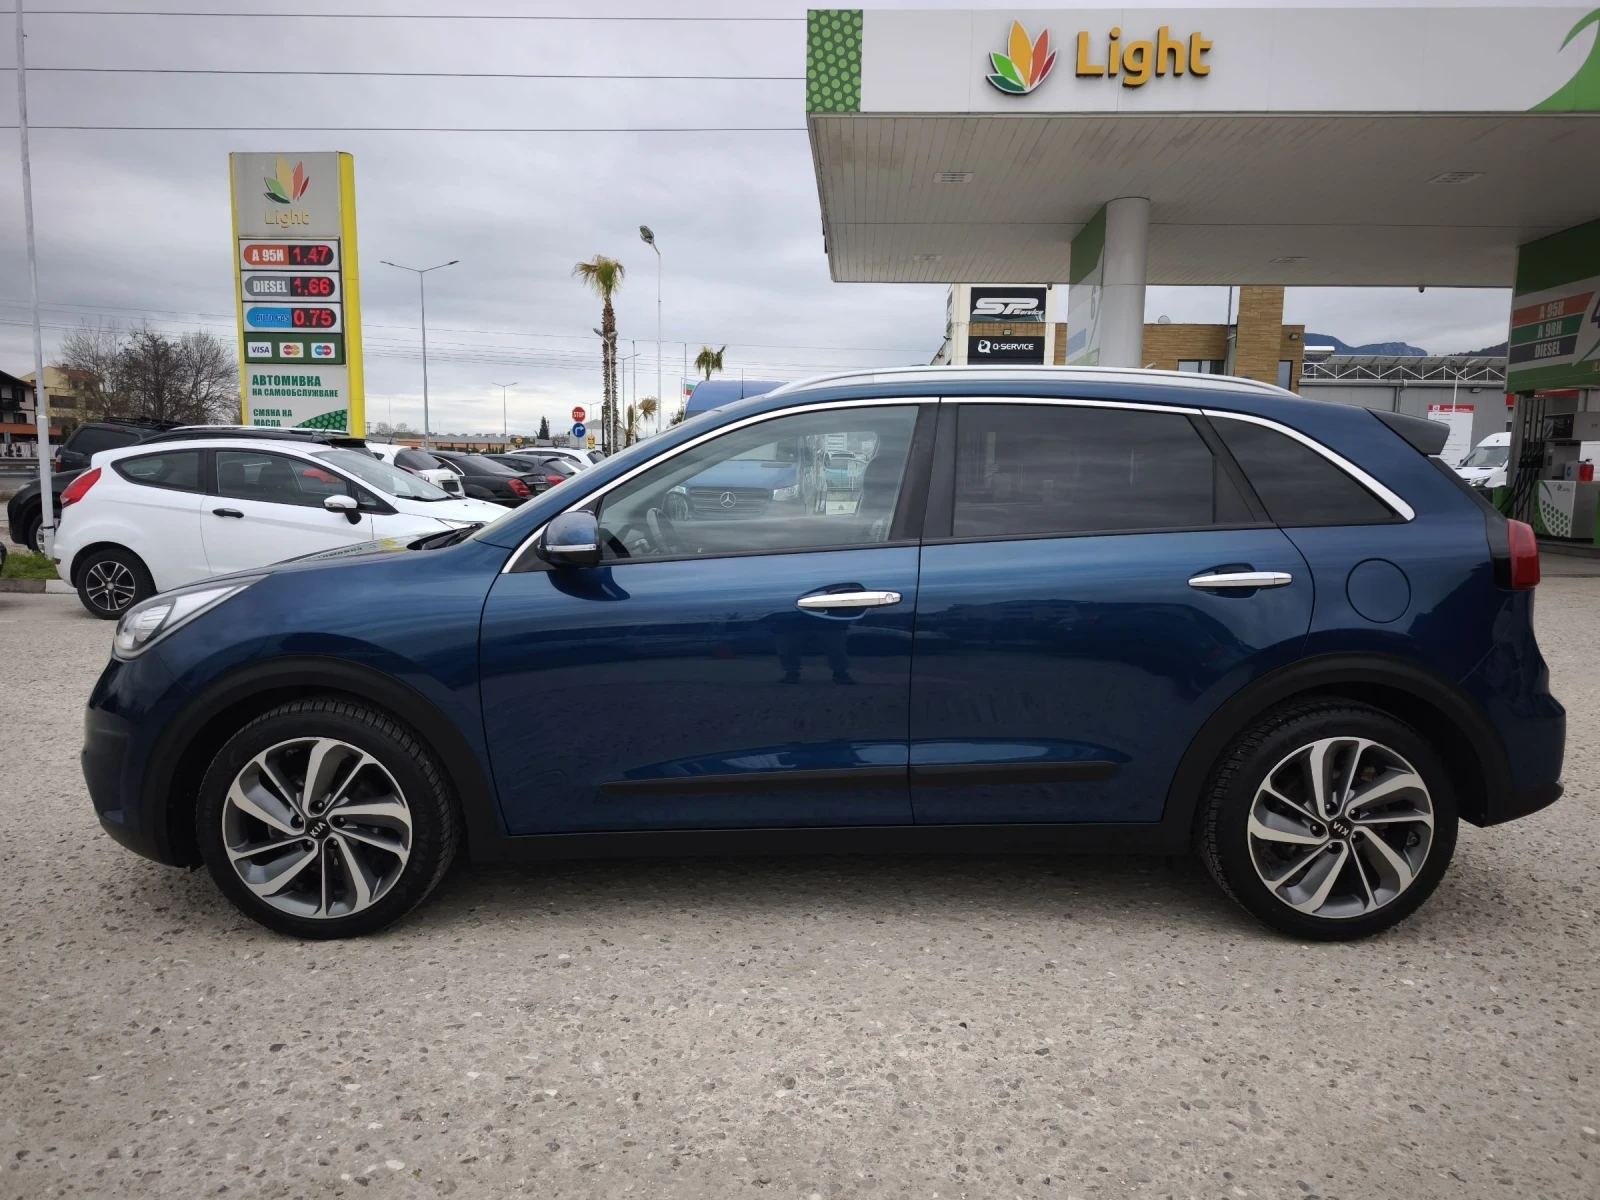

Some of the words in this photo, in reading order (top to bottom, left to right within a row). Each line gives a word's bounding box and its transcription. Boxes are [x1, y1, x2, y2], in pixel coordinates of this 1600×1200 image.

[1075, 26, 1213, 88] Light
[264, 209, 310, 228] Light
[253, 281, 287, 293] DIESEL
[972, 298, 1039, 315] SP
[1534, 341, 1560, 358] DIESEL
[252, 374, 321, 387] АВТОМИВКА
[252, 388, 263, 396] НА
[264, 388, 339, 398] САМООБСЛУЖВАНЕ
[253, 409, 281, 417] СМЯНА
[282, 409, 293, 417] НА
[309, 821, 327, 838] KIA
[1333, 821, 1350, 836] KIA
